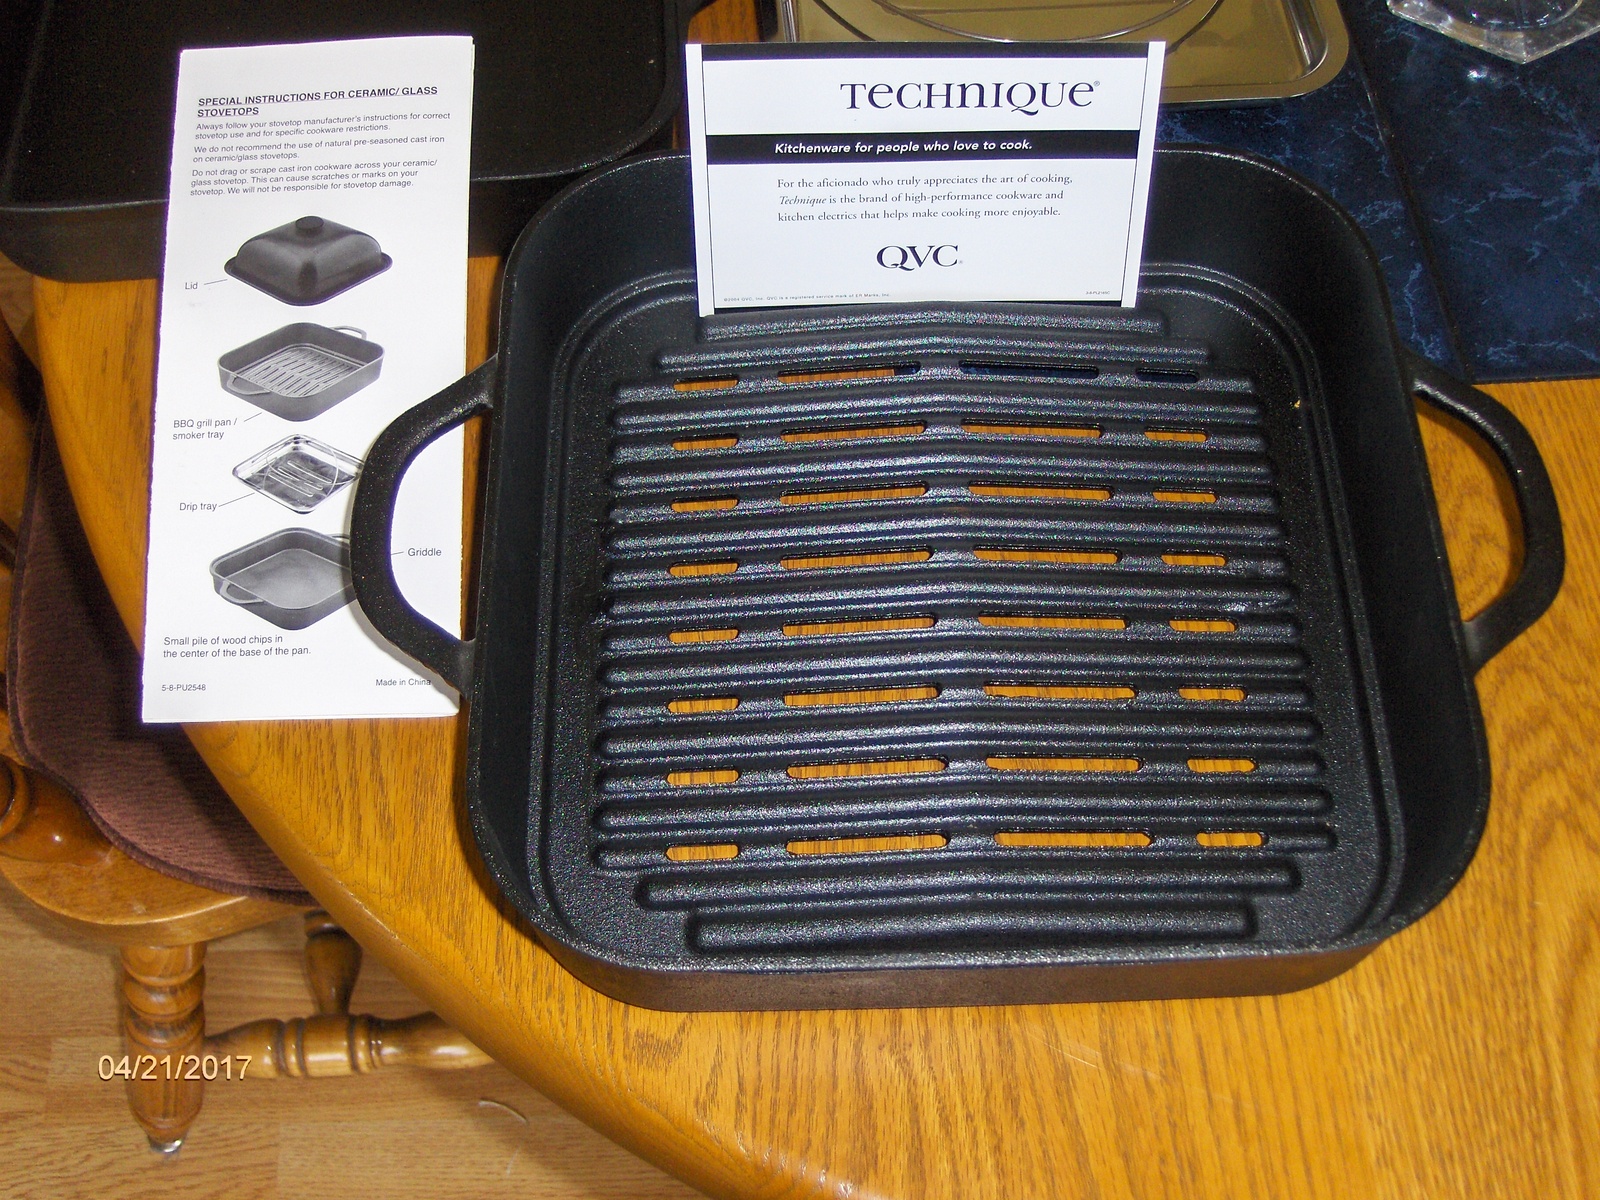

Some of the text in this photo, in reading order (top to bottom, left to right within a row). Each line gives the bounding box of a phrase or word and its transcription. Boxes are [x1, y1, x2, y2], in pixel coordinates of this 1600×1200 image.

[198, 86, 438, 106] SPECIAL INSTRUCTIONS FOR CERAMIC/ GLASS
[197, 107, 259, 117] STOVETOPS
[196, 123, 224, 131] Always
[304, 116, 361, 126] manufacturer's
[363, 114, 408, 122] instructions
[195, 132, 228, 140] stovetop
[275, 128, 305, 138] specific
[235, 143, 282, 152] recommend
[325, 139, 352, 147] natural
[354, 136, 408, 147] pre-seasoned
[775, 139, 1032, 155] Kitchenware for people who love to cook.
[204, 154, 258, 163] ceramic/glass
[219, 169, 238, 177] drag
[402, 159, 438, 167] ceramic/
[191, 179, 212, 188] glass
[311, 173, 350, 181] scratches
[400, 170, 419, 178] your
[778, 179, 794, 188] For
[798, 178, 814, 188] the
[817, 177, 869, 187] aficionado
[872, 177, 894, 186] who
[897, 176, 921, 188] truly
[924, 175, 978, 188] appreciates
[982, 174, 997, 184] the
[1017, 173, 1030, 183] of
[1030, 174, 1072, 185] cooking,
[190, 188, 225, 196] stovetop.
[283, 183, 329, 193] responsible
[378, 180, 413, 188] damage.
[780, 190, 1064, 207] Technique is the brand of high-performance cookware and
[778, 212, 814, 222] kitchen
[818, 212, 857, 221] electrics
[860, 210, 880, 219] that
[883, 209, 908, 221] helps
[912, 208, 938, 218] make
[941, 208, 981, 219] cooking
[1012, 206, 1060, 218] enjoyable.
[185, 282, 198, 290] Lid
[173, 419, 194, 429] BBQ
[196, 419, 212, 430] grill
[214, 419, 232, 428] pan
[172, 431, 224, 440] smoker tray
[179, 502, 218, 512] Drip tray
[407, 548, 442, 557] Griddle
[163, 634, 283, 647] Small pile of wood chips in
[163, 647, 311, 658] the center of the base of the pan.
[161, 684, 206, 692] 5-8-PU2548
